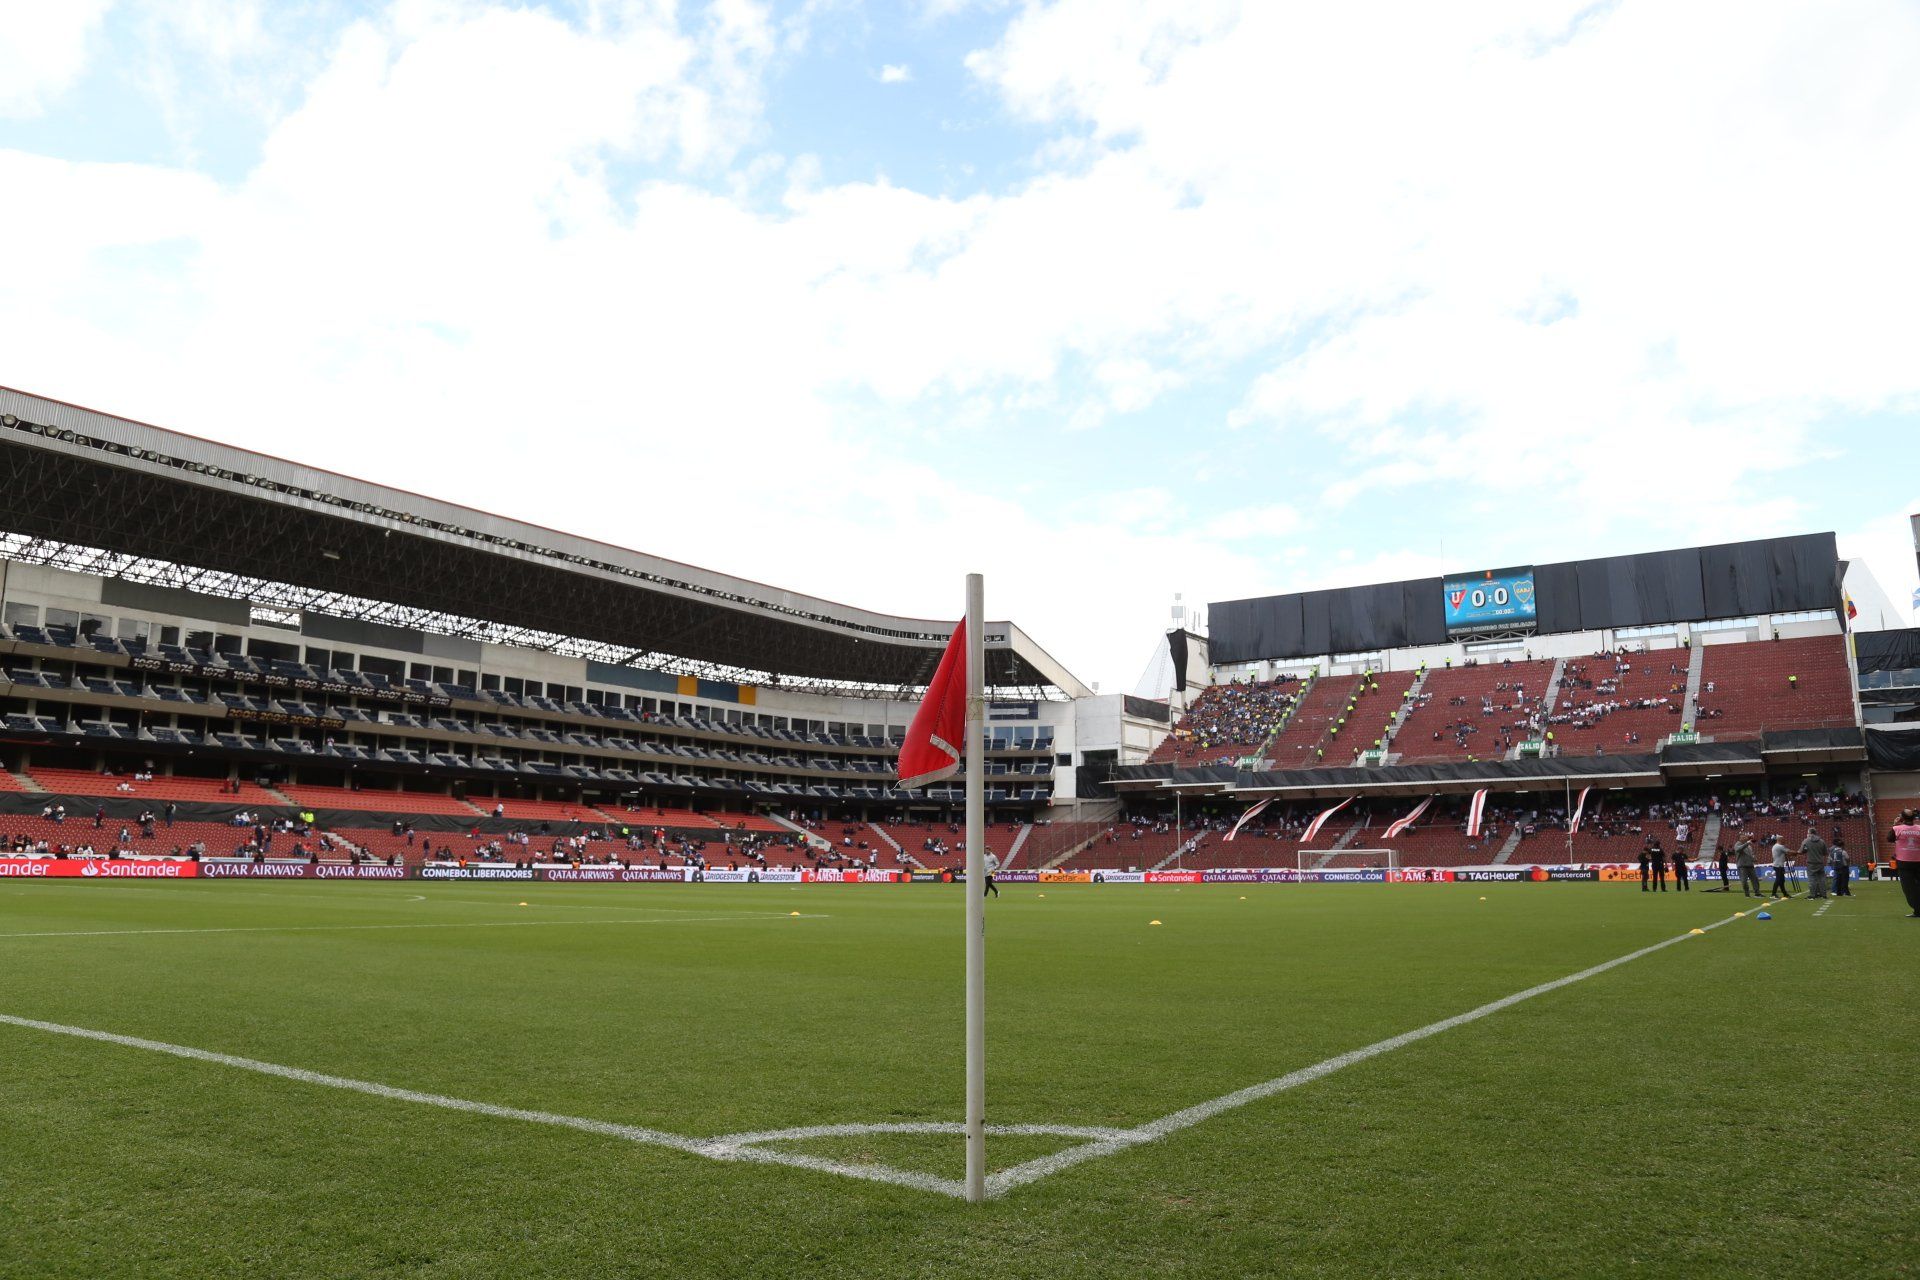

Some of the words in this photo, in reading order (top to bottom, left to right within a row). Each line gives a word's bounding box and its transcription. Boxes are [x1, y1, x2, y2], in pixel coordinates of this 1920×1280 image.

[101, 861, 182, 877] Santander
[204, 863, 248, 878] QATAR
[251, 864, 304, 877] AIRWAYS
[315, 865, 355, 879] QATAR
[357, 866, 404, 878] AIRWAYS
[422, 867, 472, 878] CONMEBOL
[473, 867, 533, 879] LIBERTADORES
[548, 868, 578, 881] QATAR
[580, 869, 615, 880] AIRWAYS
[622, 870, 649, 882] QATAR
[651, 871, 682, 881] AIRWAYS
[705, 872, 744, 882] BRIDGESTONE
[759, 872, 796, 881] BRIDGESTONE
[816, 871, 845, 882] AMSTEL
[865, 871, 891, 882] AMSTEL
[992, 874, 1012, 882] QATAR
[1104, 874, 1142, 882] BRIDGESTONE
[1157, 873, 1195, 882] Santander
[1202, 873, 1226, 882] QATAR
[1227, 873, 1258, 881] AIRWAYS
[1261, 873, 1286, 882] QATAR
[1551, 871, 1591, 879] mastercard
